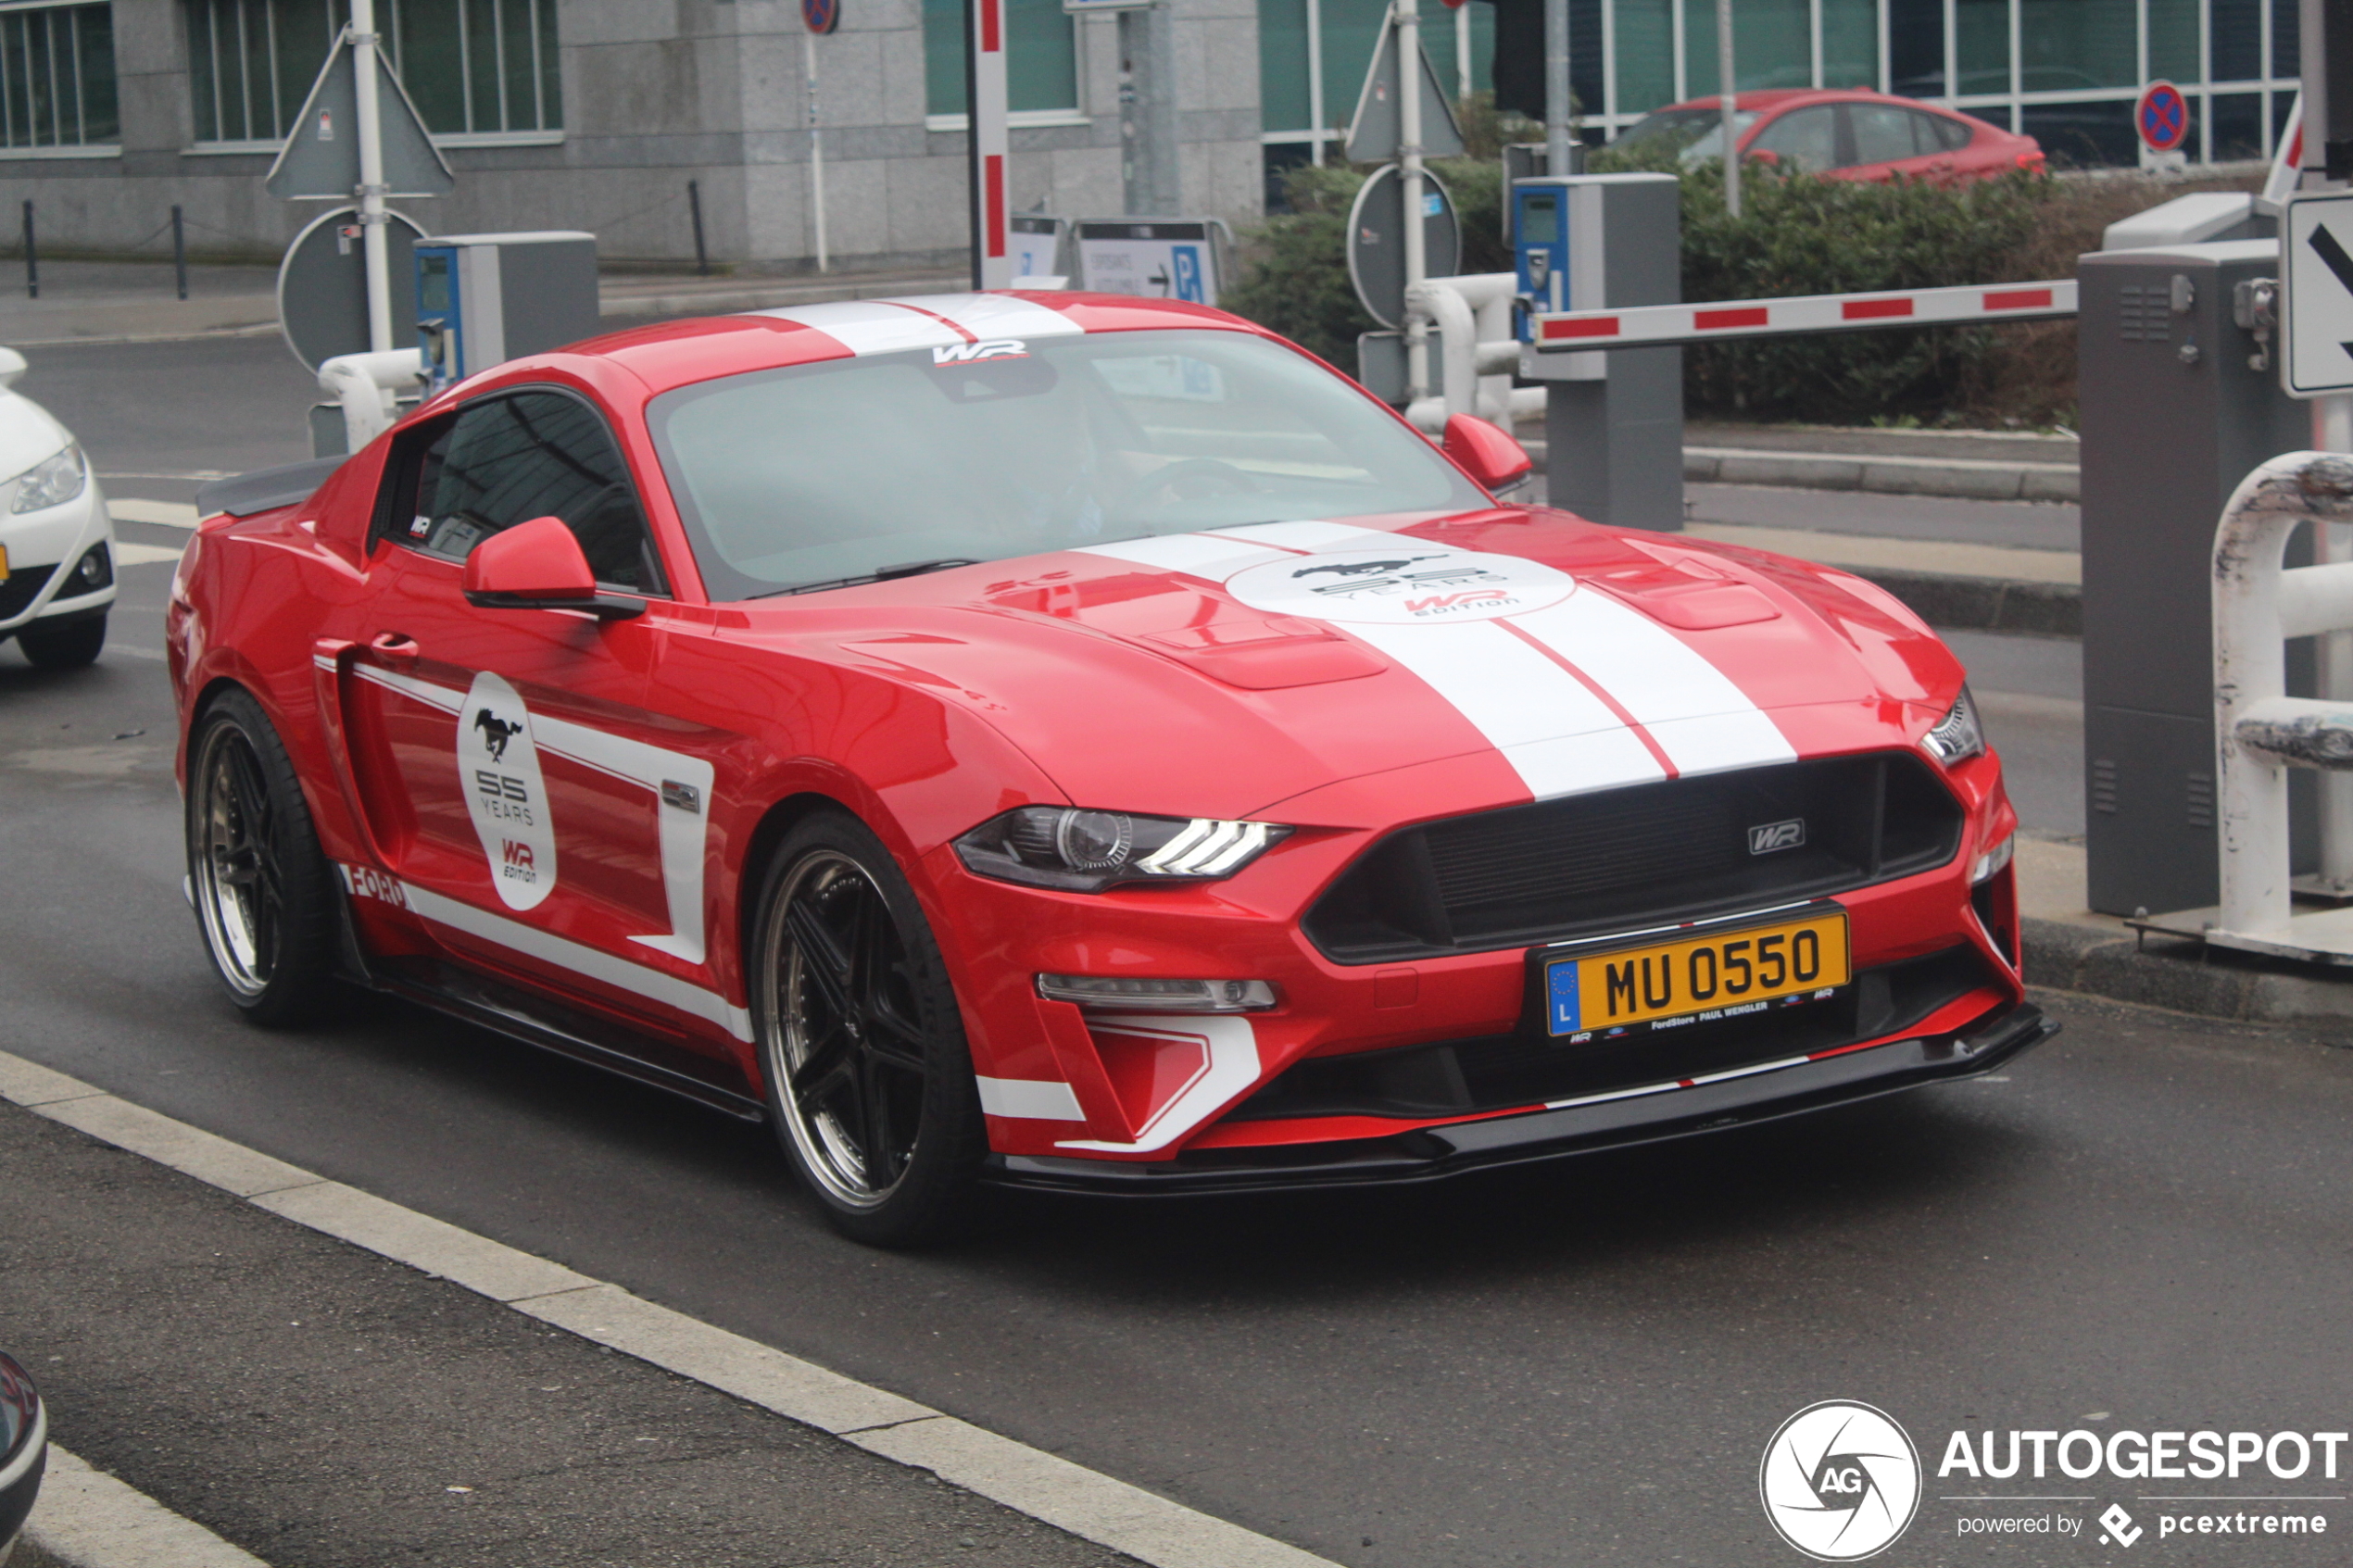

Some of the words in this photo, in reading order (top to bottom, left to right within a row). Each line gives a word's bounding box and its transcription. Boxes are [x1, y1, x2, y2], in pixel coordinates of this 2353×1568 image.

[933, 339, 1026, 364] WR
[1309, 567, 1490, 596] 55
[1332, 573, 1508, 601] YEARS
[1403, 589, 1508, 612] WR
[474, 769, 528, 803] 55
[481, 797, 534, 827] YEARS
[1754, 822, 1800, 851] WR
[501, 837, 535, 872] WR
[347, 863, 408, 909] FORD
[1604, 953, 1672, 1017] MU
[1688, 928, 1820, 1001] 0550
[1559, 1003, 1571, 1022] L
[1651, 1015, 1695, 1031] FordStore
[1699, 1010, 1723, 1022] PAUL
[1724, 1001, 1768, 1018] WENGLER
